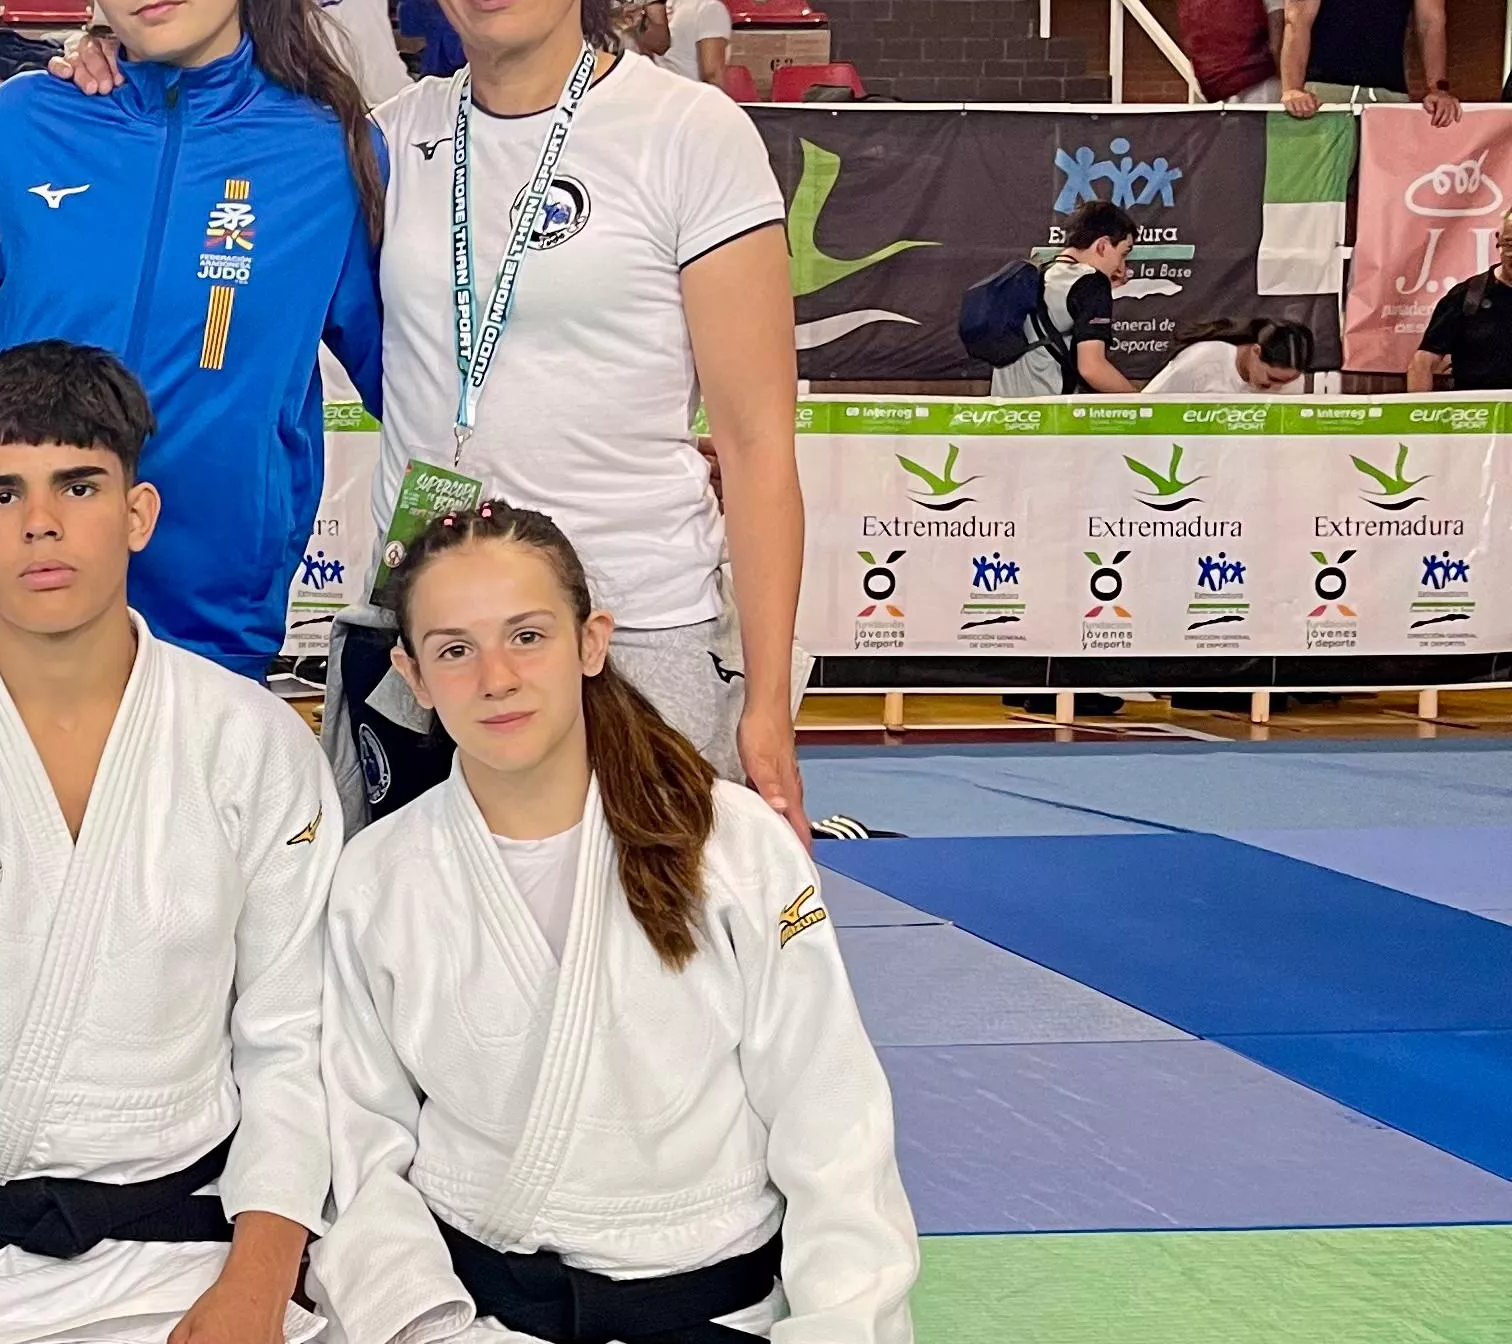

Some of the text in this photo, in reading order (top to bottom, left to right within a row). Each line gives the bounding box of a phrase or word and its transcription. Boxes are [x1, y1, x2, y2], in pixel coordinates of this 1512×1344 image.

[569, 50, 595, 100] JUDO
[453, 113, 474, 362] JUDO MORE THAN SPORT
[471, 122, 568, 388] JUDO MORE THAN SPORT
[197, 265, 250, 281] JUDO
[1140, 263, 1192, 278] la Base
[1110, 318, 1176, 332] eneral de
[862, 406, 912, 420] Interreg
[1088, 407, 1137, 420] Interreg
[1182, 408, 1267, 424] euroace
[1316, 407, 1366, 420] Interreg
[1409, 408, 1489, 424] euroace
[1226, 422, 1265, 432] SPORT
[1451, 421, 1488, 431] SPORT
[863, 516, 1015, 538] Extremadura
[1088, 516, 1242, 538] Extremadura
[1315, 515, 1465, 537] Extremadura
[863, 640, 904, 649] deporte
[1090, 640, 1132, 649] deporte
[1315, 639, 1356, 648] deporte
